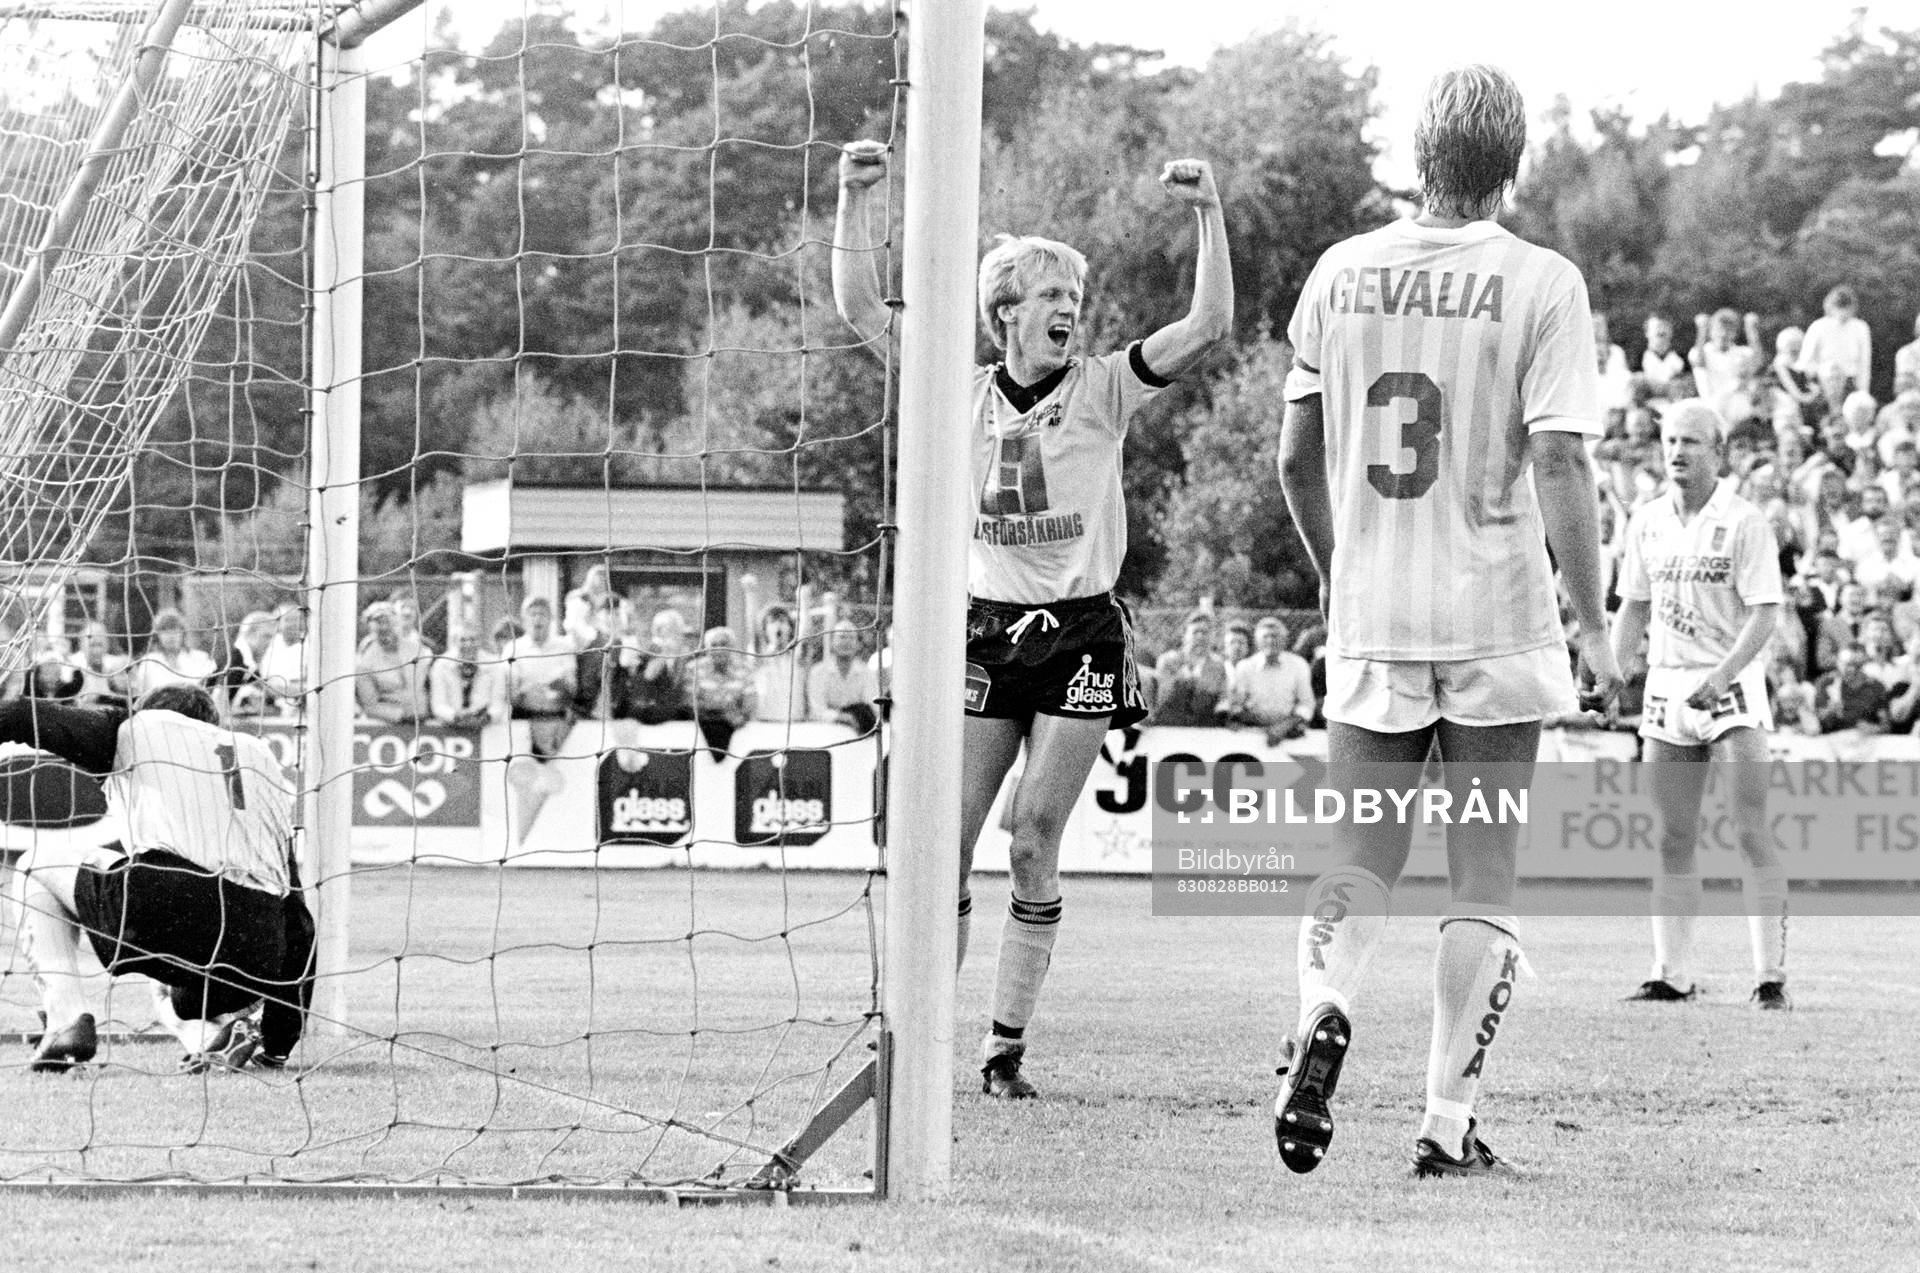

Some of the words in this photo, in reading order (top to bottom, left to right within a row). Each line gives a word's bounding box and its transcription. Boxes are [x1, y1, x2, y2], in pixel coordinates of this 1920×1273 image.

[1330, 267, 1504, 323] GEVALIA
[1367, 371, 1442, 500] 3
[1066, 681, 1114, 705] glass
[214, 743, 246, 811] 1
[613, 787, 687, 827] glass
[1560, 803, 1655, 851] FÖR
[1462, 948, 1519, 1080] KOSA
